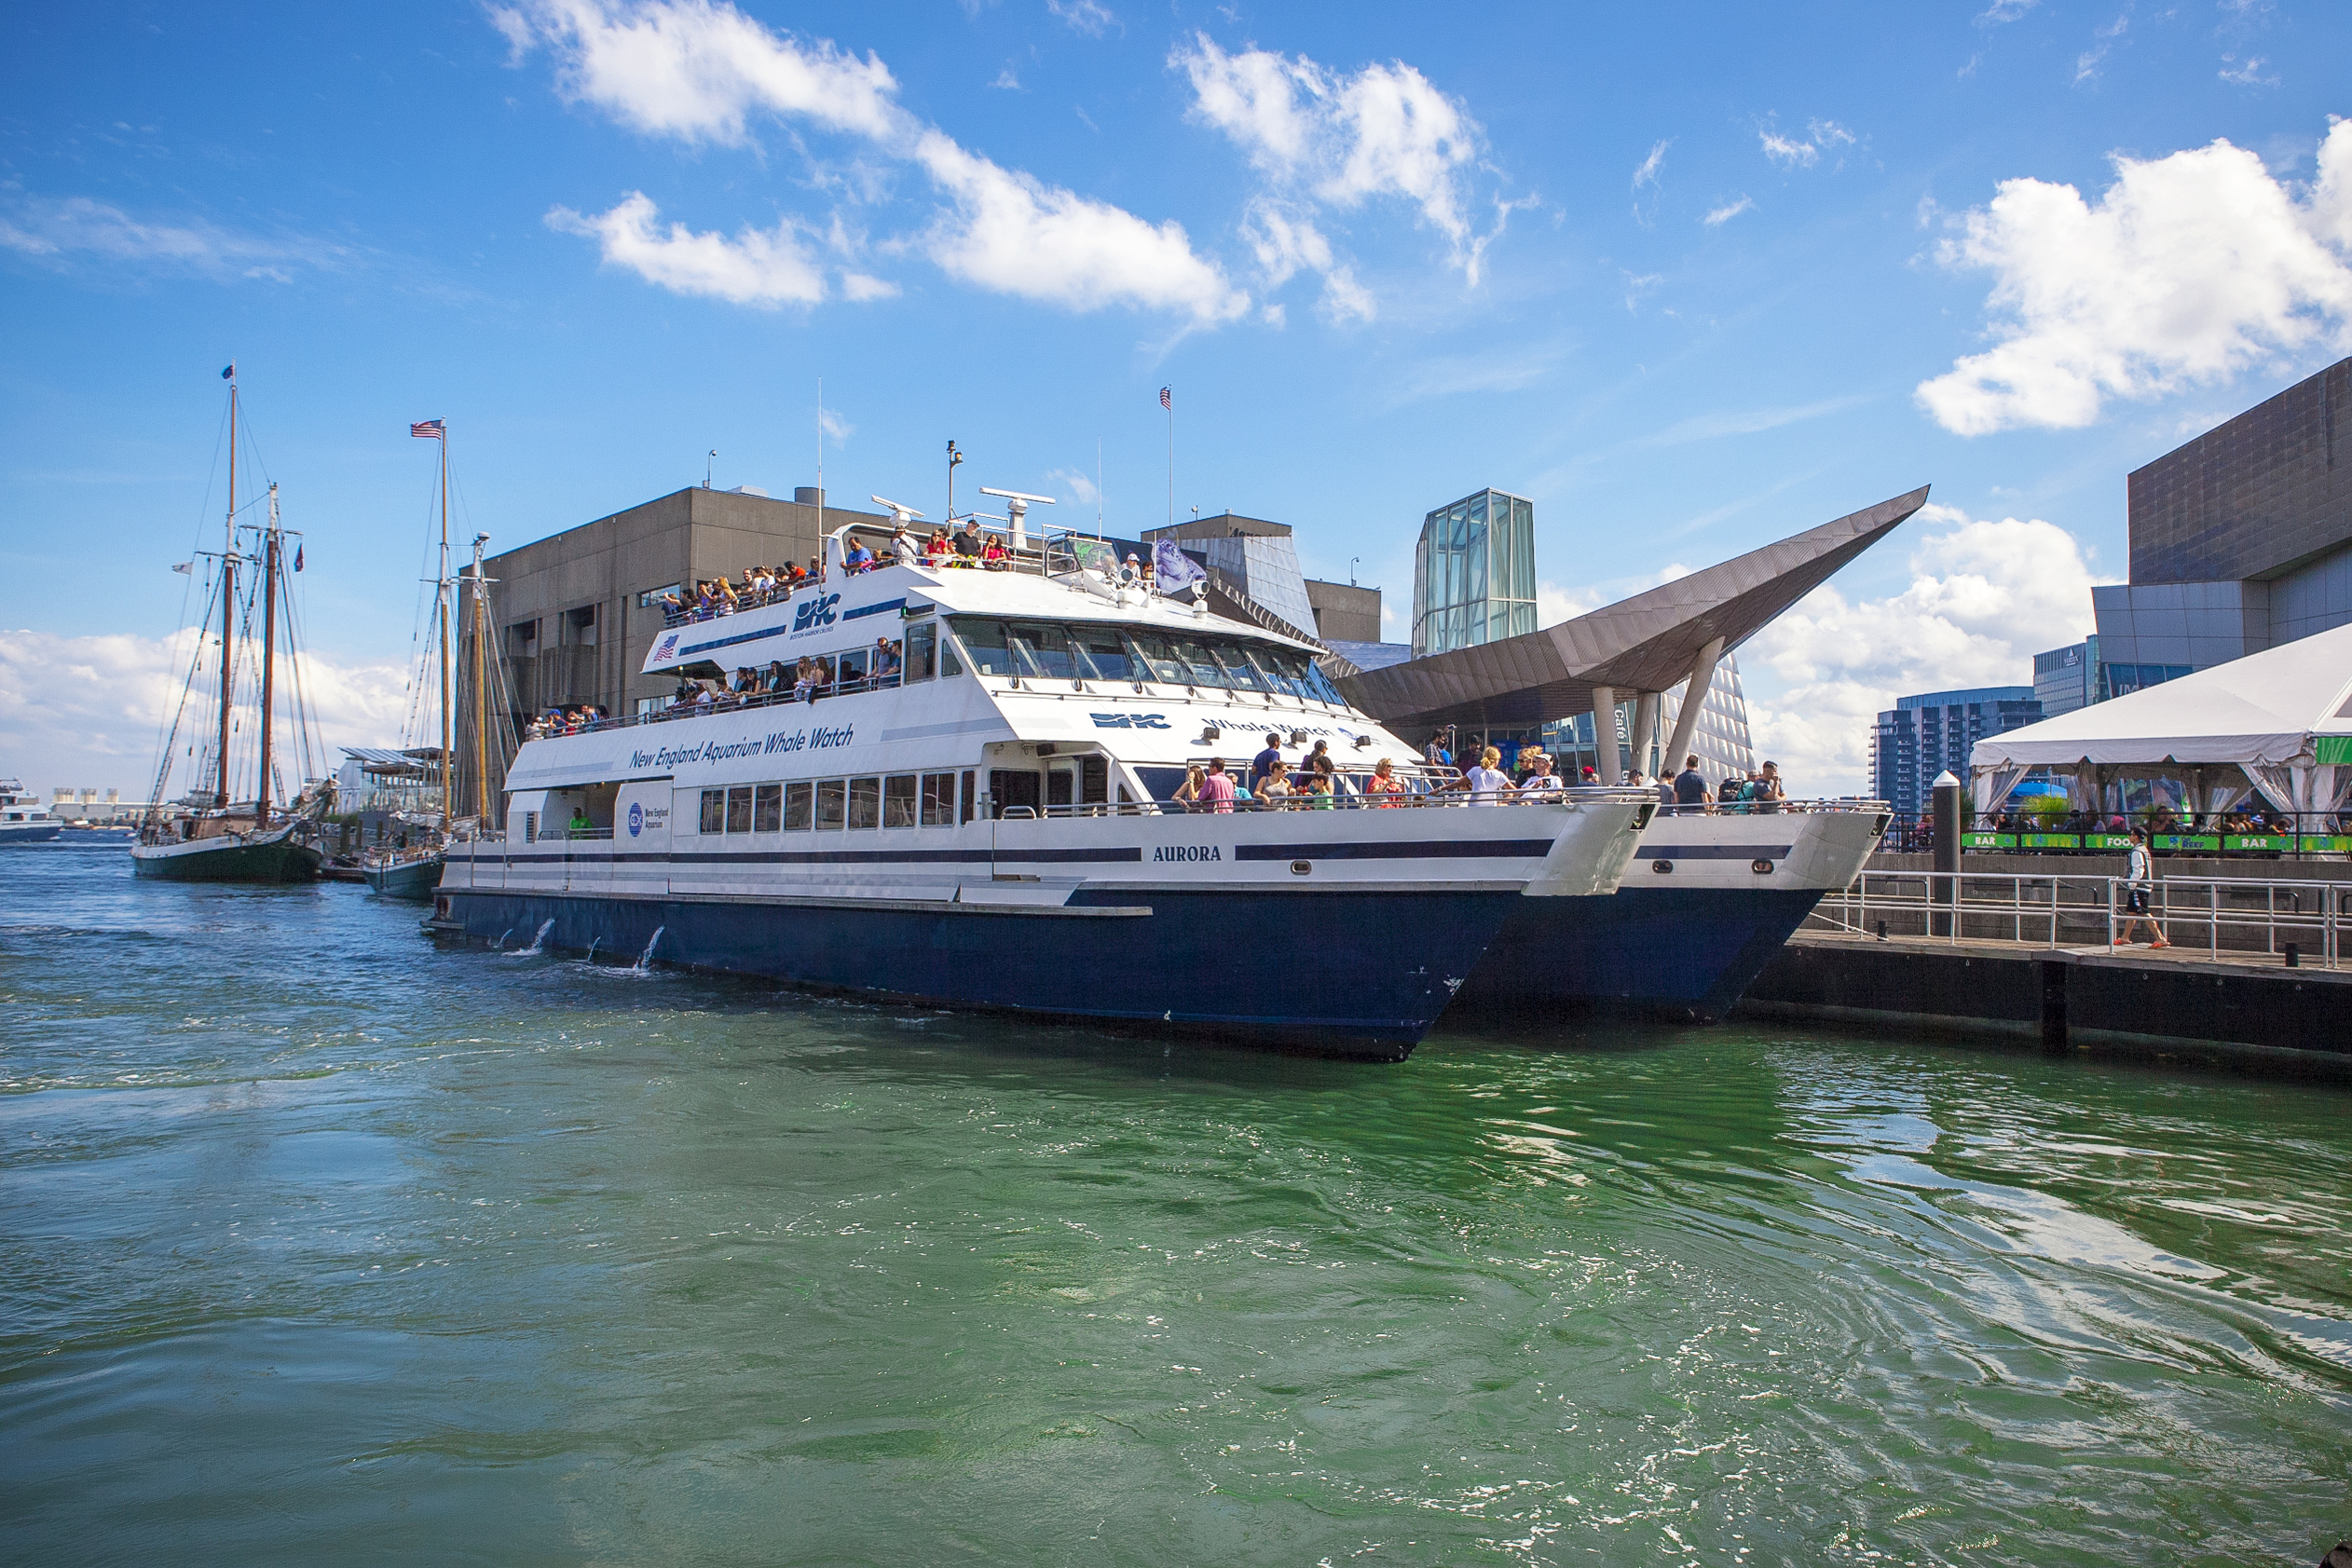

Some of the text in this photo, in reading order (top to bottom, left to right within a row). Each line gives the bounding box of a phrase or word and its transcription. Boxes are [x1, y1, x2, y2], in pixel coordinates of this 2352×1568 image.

[1201, 717, 1335, 736] Whale Watch
[1614, 709, 1627, 740] Café
[629, 722, 854, 770] New England Aquarium Whale Watch
[645, 807, 669, 819] New England
[645, 819, 663, 830] Aquarium
[1975, 836, 1996, 845] BAR
[2107, 837, 2134, 847] FOO
[2241, 838, 2267, 848] BAR
[1153, 845, 1222, 862] AURORA
